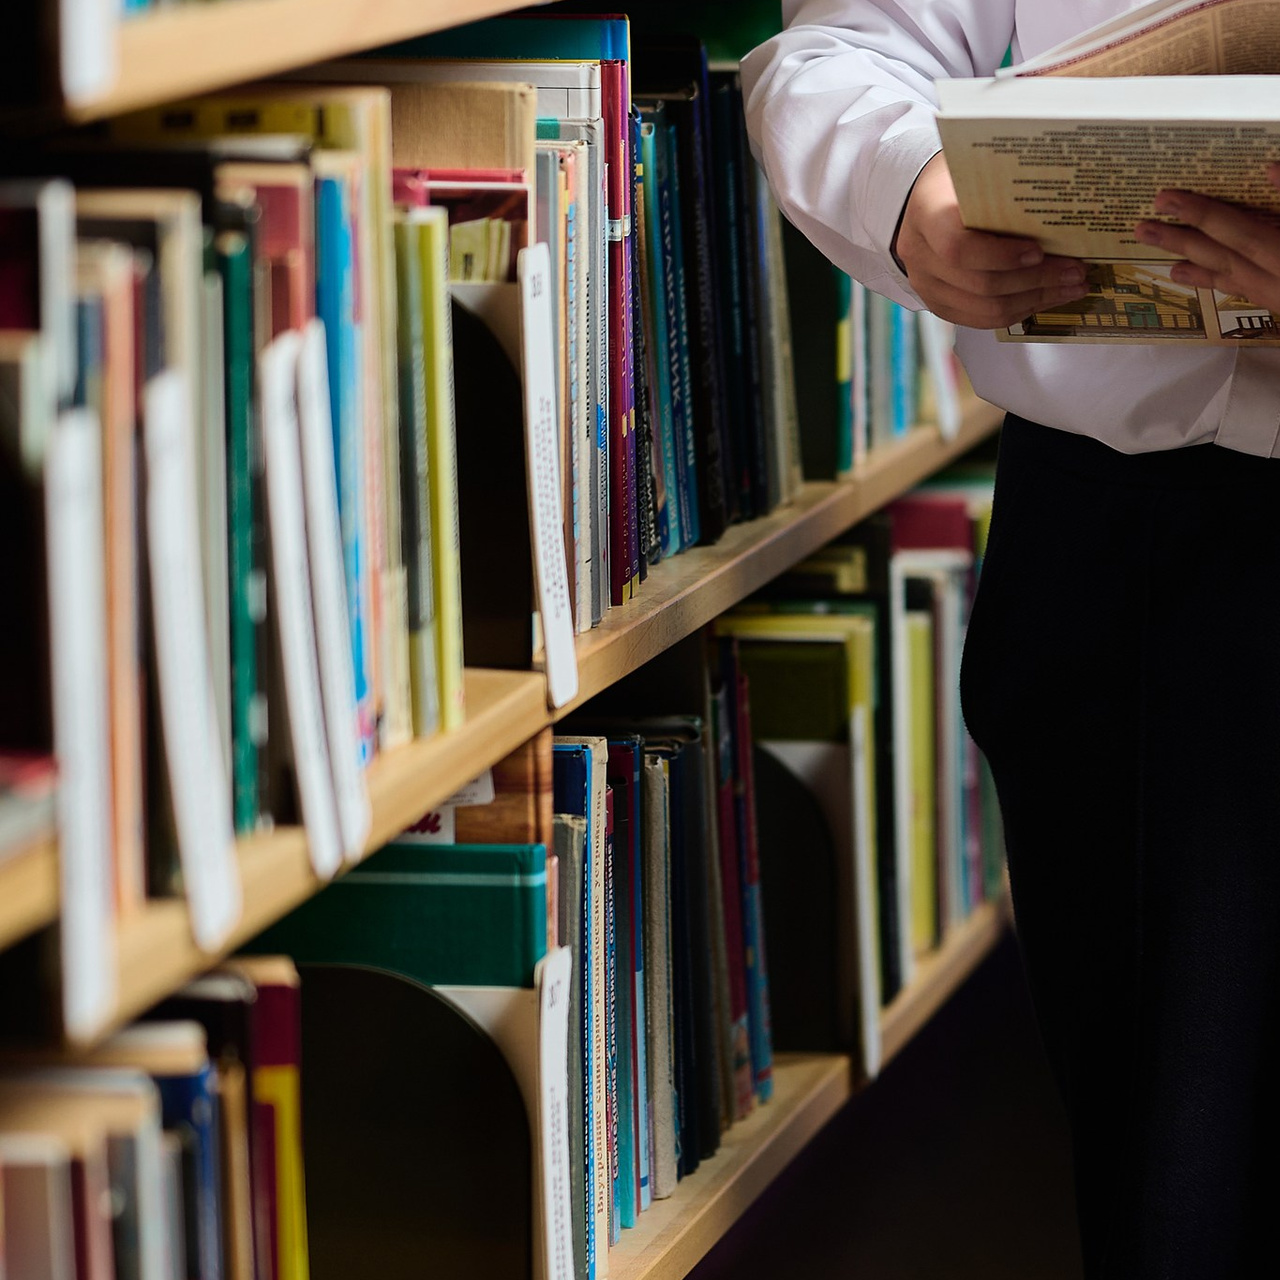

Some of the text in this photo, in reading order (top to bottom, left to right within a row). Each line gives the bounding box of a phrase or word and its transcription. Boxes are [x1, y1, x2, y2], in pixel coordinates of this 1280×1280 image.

[663, 188, 682, 409] СПРАВОЧНИК
[679, 266, 690, 347] РАБОТЫ
[683, 355, 696, 467] ПАРКЕТНЫЕ
[594, 789, 603, 889] устройства
[594, 1110, 605, 1215] Внутренние
